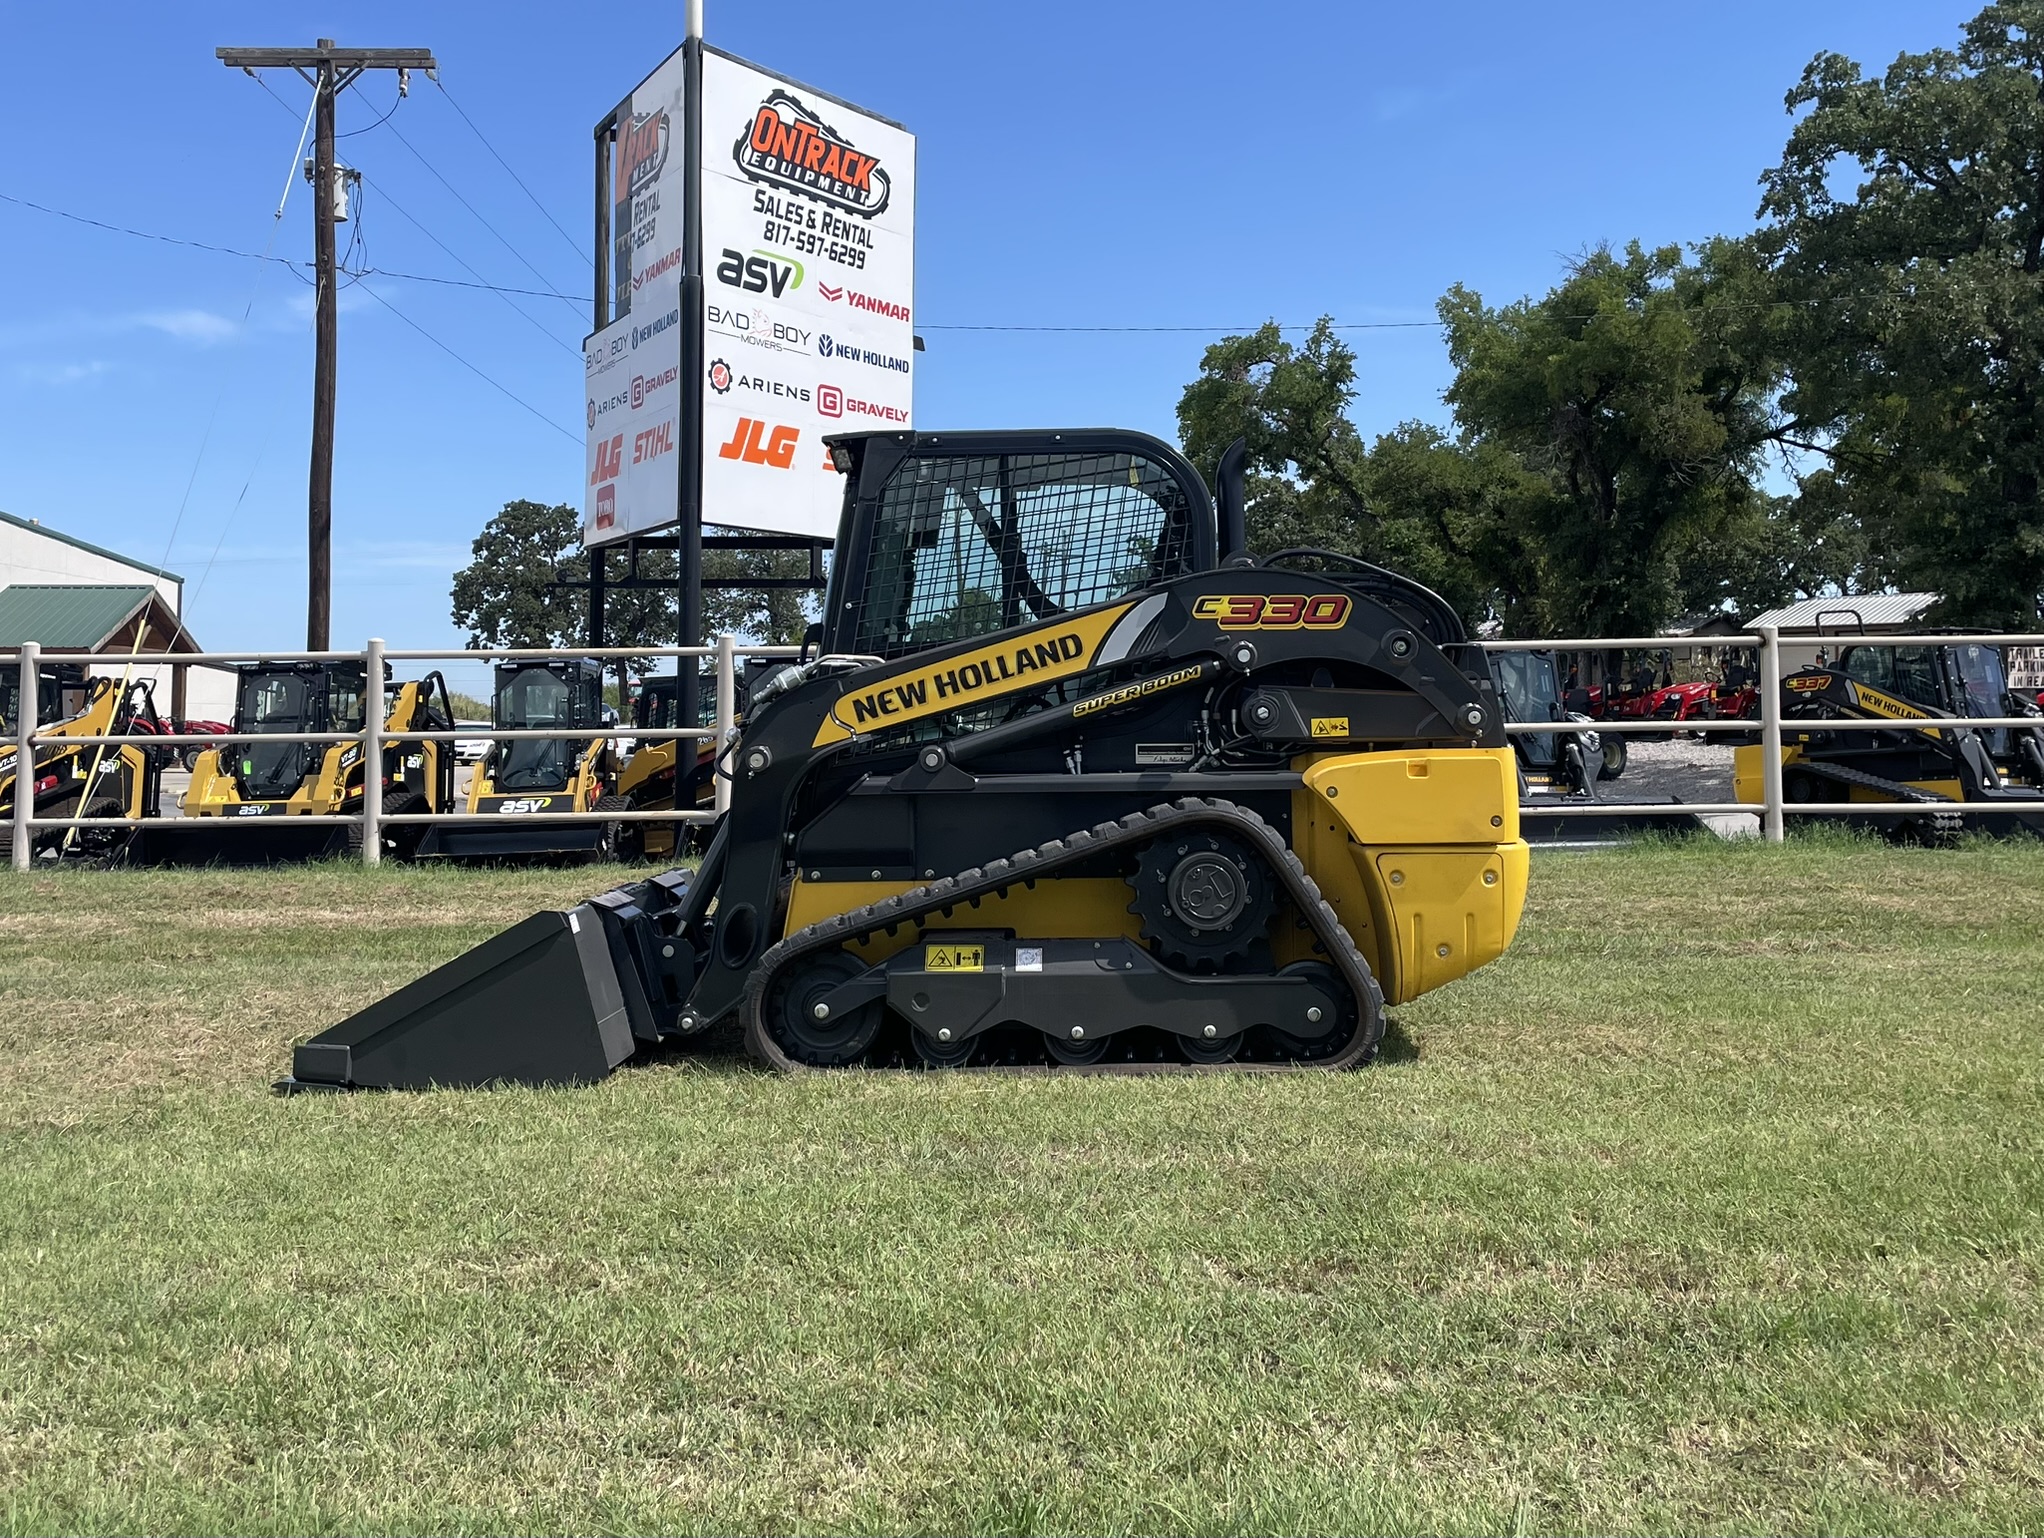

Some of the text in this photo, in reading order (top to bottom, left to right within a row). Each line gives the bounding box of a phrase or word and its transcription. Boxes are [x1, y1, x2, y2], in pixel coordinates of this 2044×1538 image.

[751, 153, 869, 204] EQUIPMENT
[634, 188, 660, 228] RENTAL
[753, 189, 874, 249] SALES & RENTAL
[763, 220, 866, 270] 817-597-6299
[644, 247, 681, 283] YANMAR
[847, 290, 910, 322] YANMAR
[639, 309, 679, 343] NEW HOLLAND
[708, 306, 811, 346] BAD BOY
[740, 334, 783, 352] MOWERS
[611, 333, 629, 356] BOY
[836, 343, 909, 373] NEW HOLLAND
[645, 365, 679, 394] GRAVELY
[738, 375, 811, 402] ARIENS
[597, 391, 628, 416] ARIENS
[846, 398, 909, 423] GRAVELY
[590, 433, 624, 486] JLG
[632, 420, 673, 465] STIHL
[718, 417, 800, 469] JLG
[1192, 594, 1353, 630] C330
[852, 633, 1083, 724] NEW HOLLAND
[1073, 665, 1201, 717] SUPER BOOM
[2013, 675, 2023, 687] IN
[1861, 692, 1884, 708] NEW
